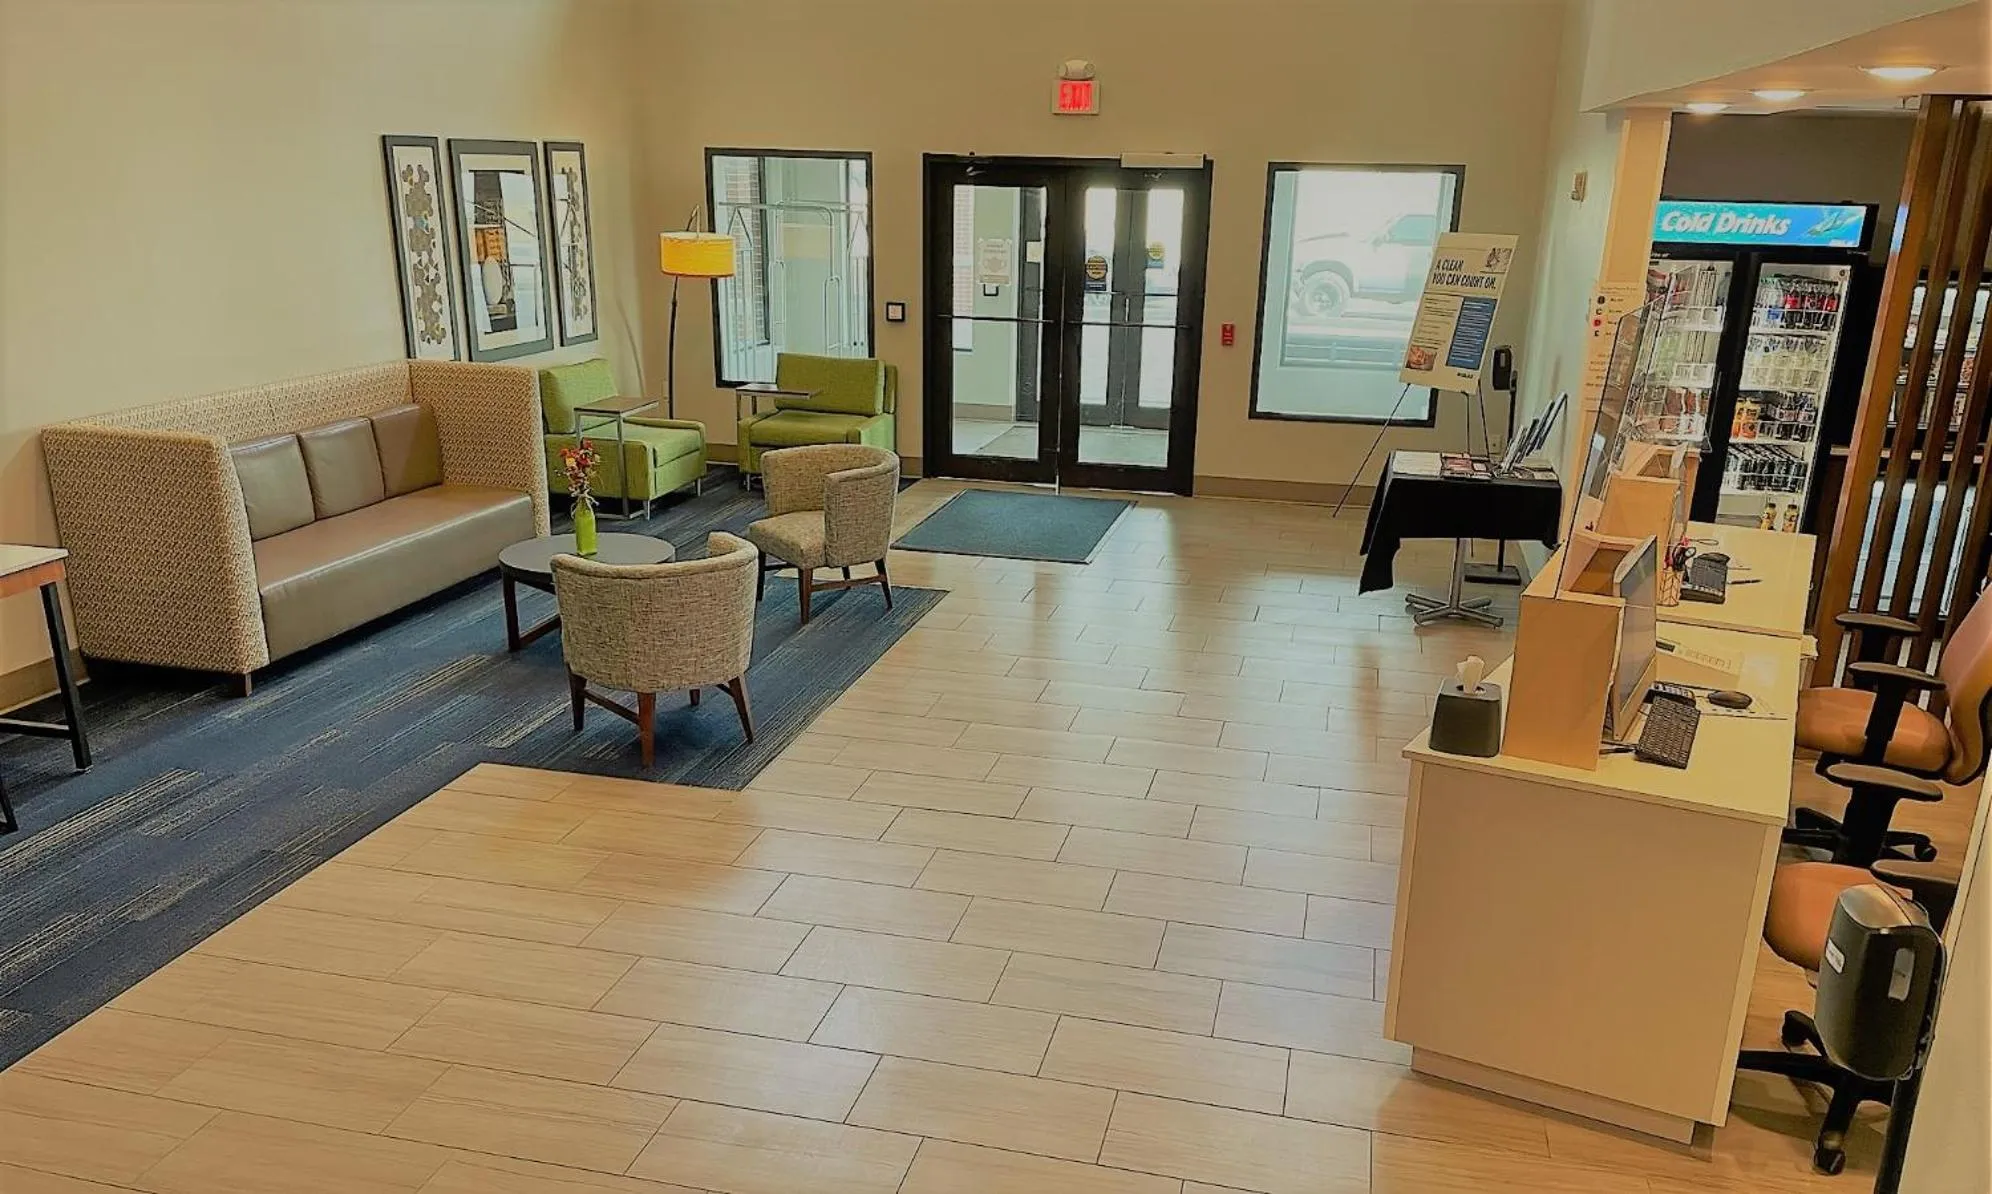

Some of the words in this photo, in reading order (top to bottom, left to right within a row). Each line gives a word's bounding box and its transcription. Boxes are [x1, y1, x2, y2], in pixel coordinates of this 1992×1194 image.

[1060, 83, 1092, 108] EXIT
[1661, 210, 1716, 234] Cold
[1715, 210, 1792, 236] Drinks
[1435, 259, 1442, 271] A
[1441, 259, 1464, 272] CLEAN
[1432, 272, 1446, 285] YOU
[1446, 273, 1462, 286] CAN
[1461, 274, 1485, 288] COUNT
